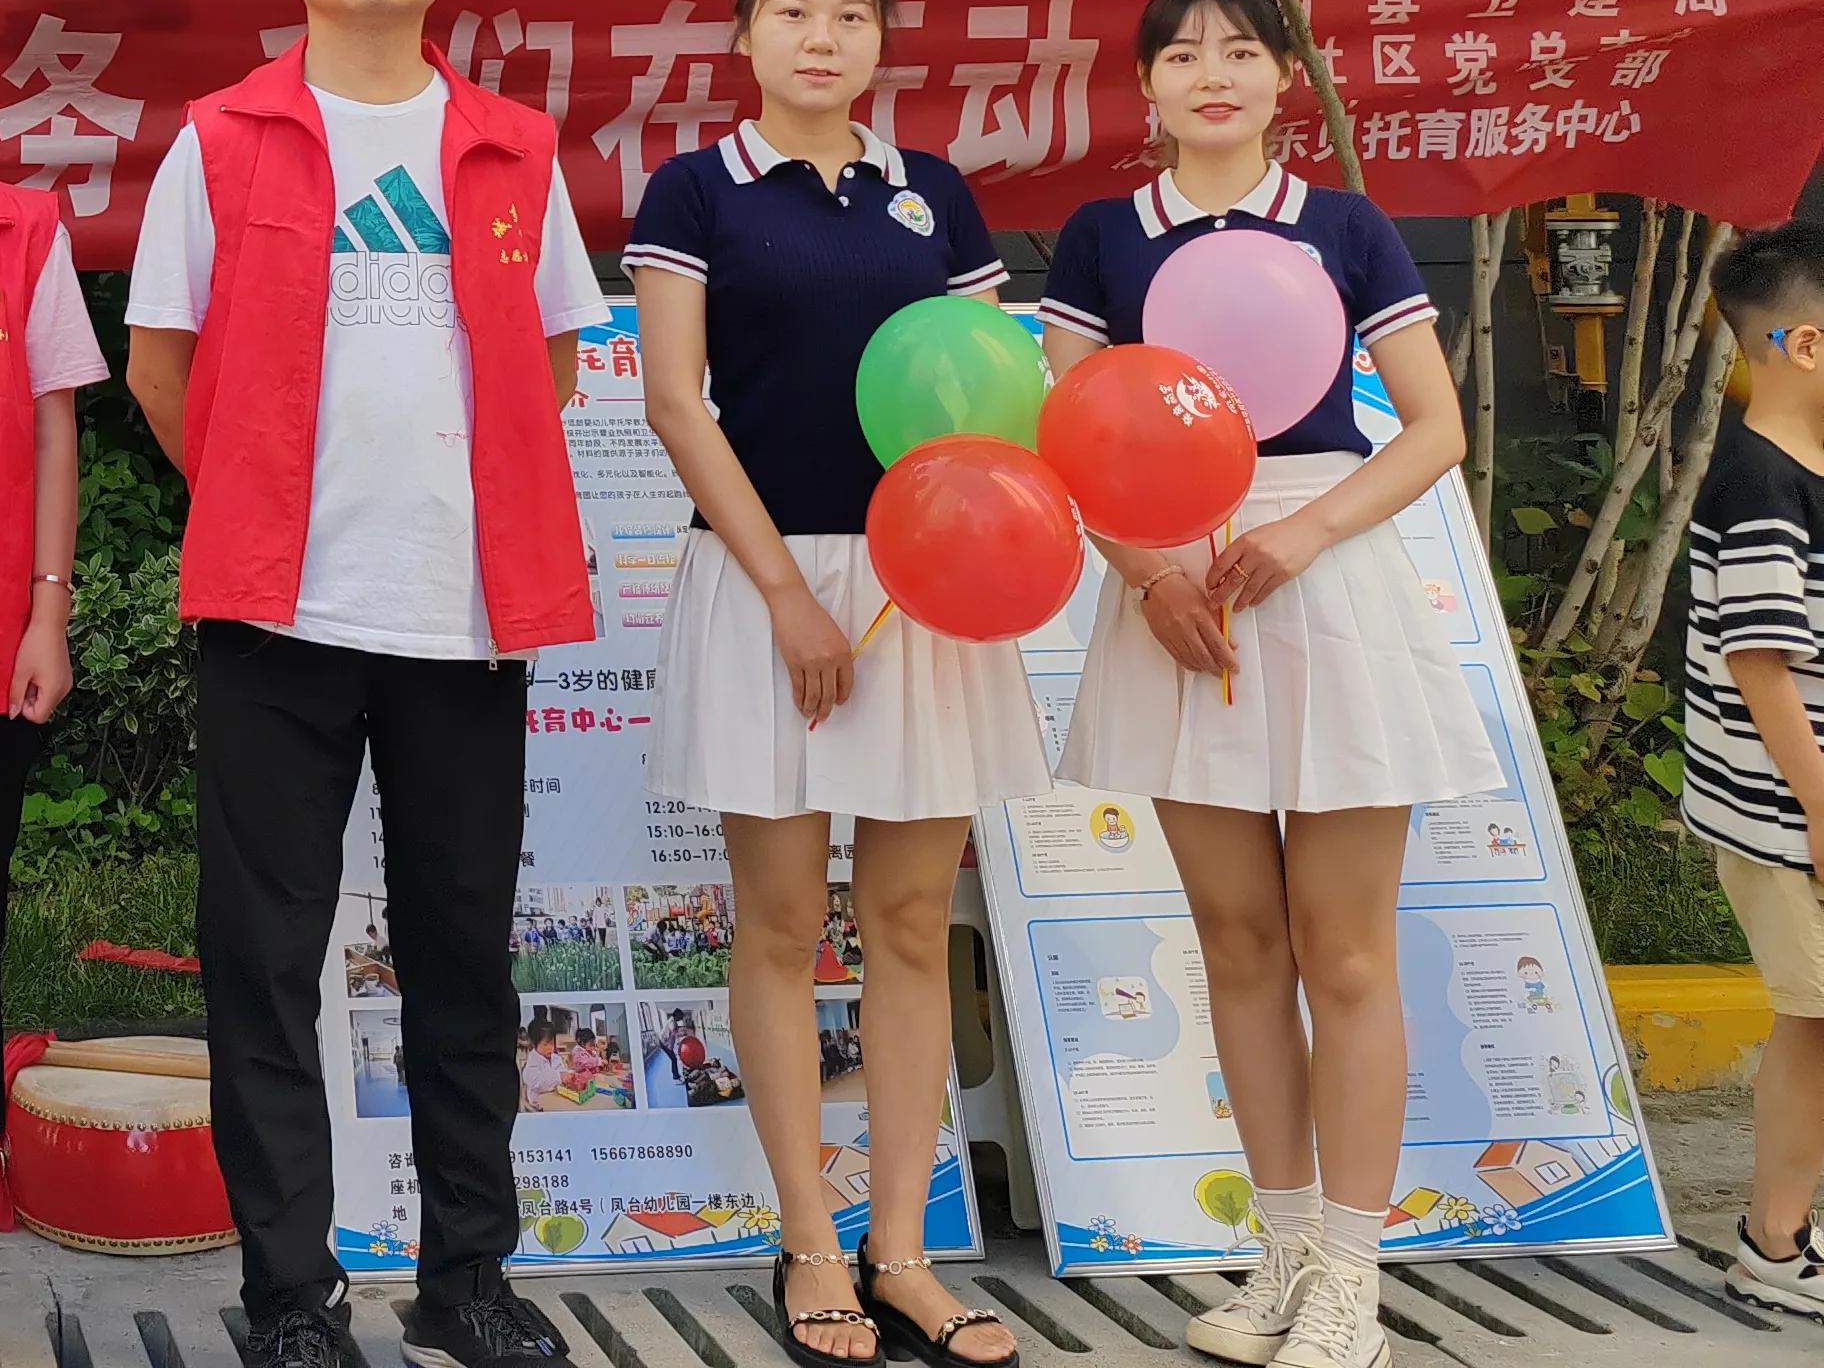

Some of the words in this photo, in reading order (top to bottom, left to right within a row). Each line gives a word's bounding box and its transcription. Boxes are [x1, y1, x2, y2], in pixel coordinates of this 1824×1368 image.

[524, 777, 561, 794] 时间
[590, 1143, 694, 1161] 15667868890
[517, 1190, 765, 1218] 凤台路4号（凤台幼儿园一楼东边）
